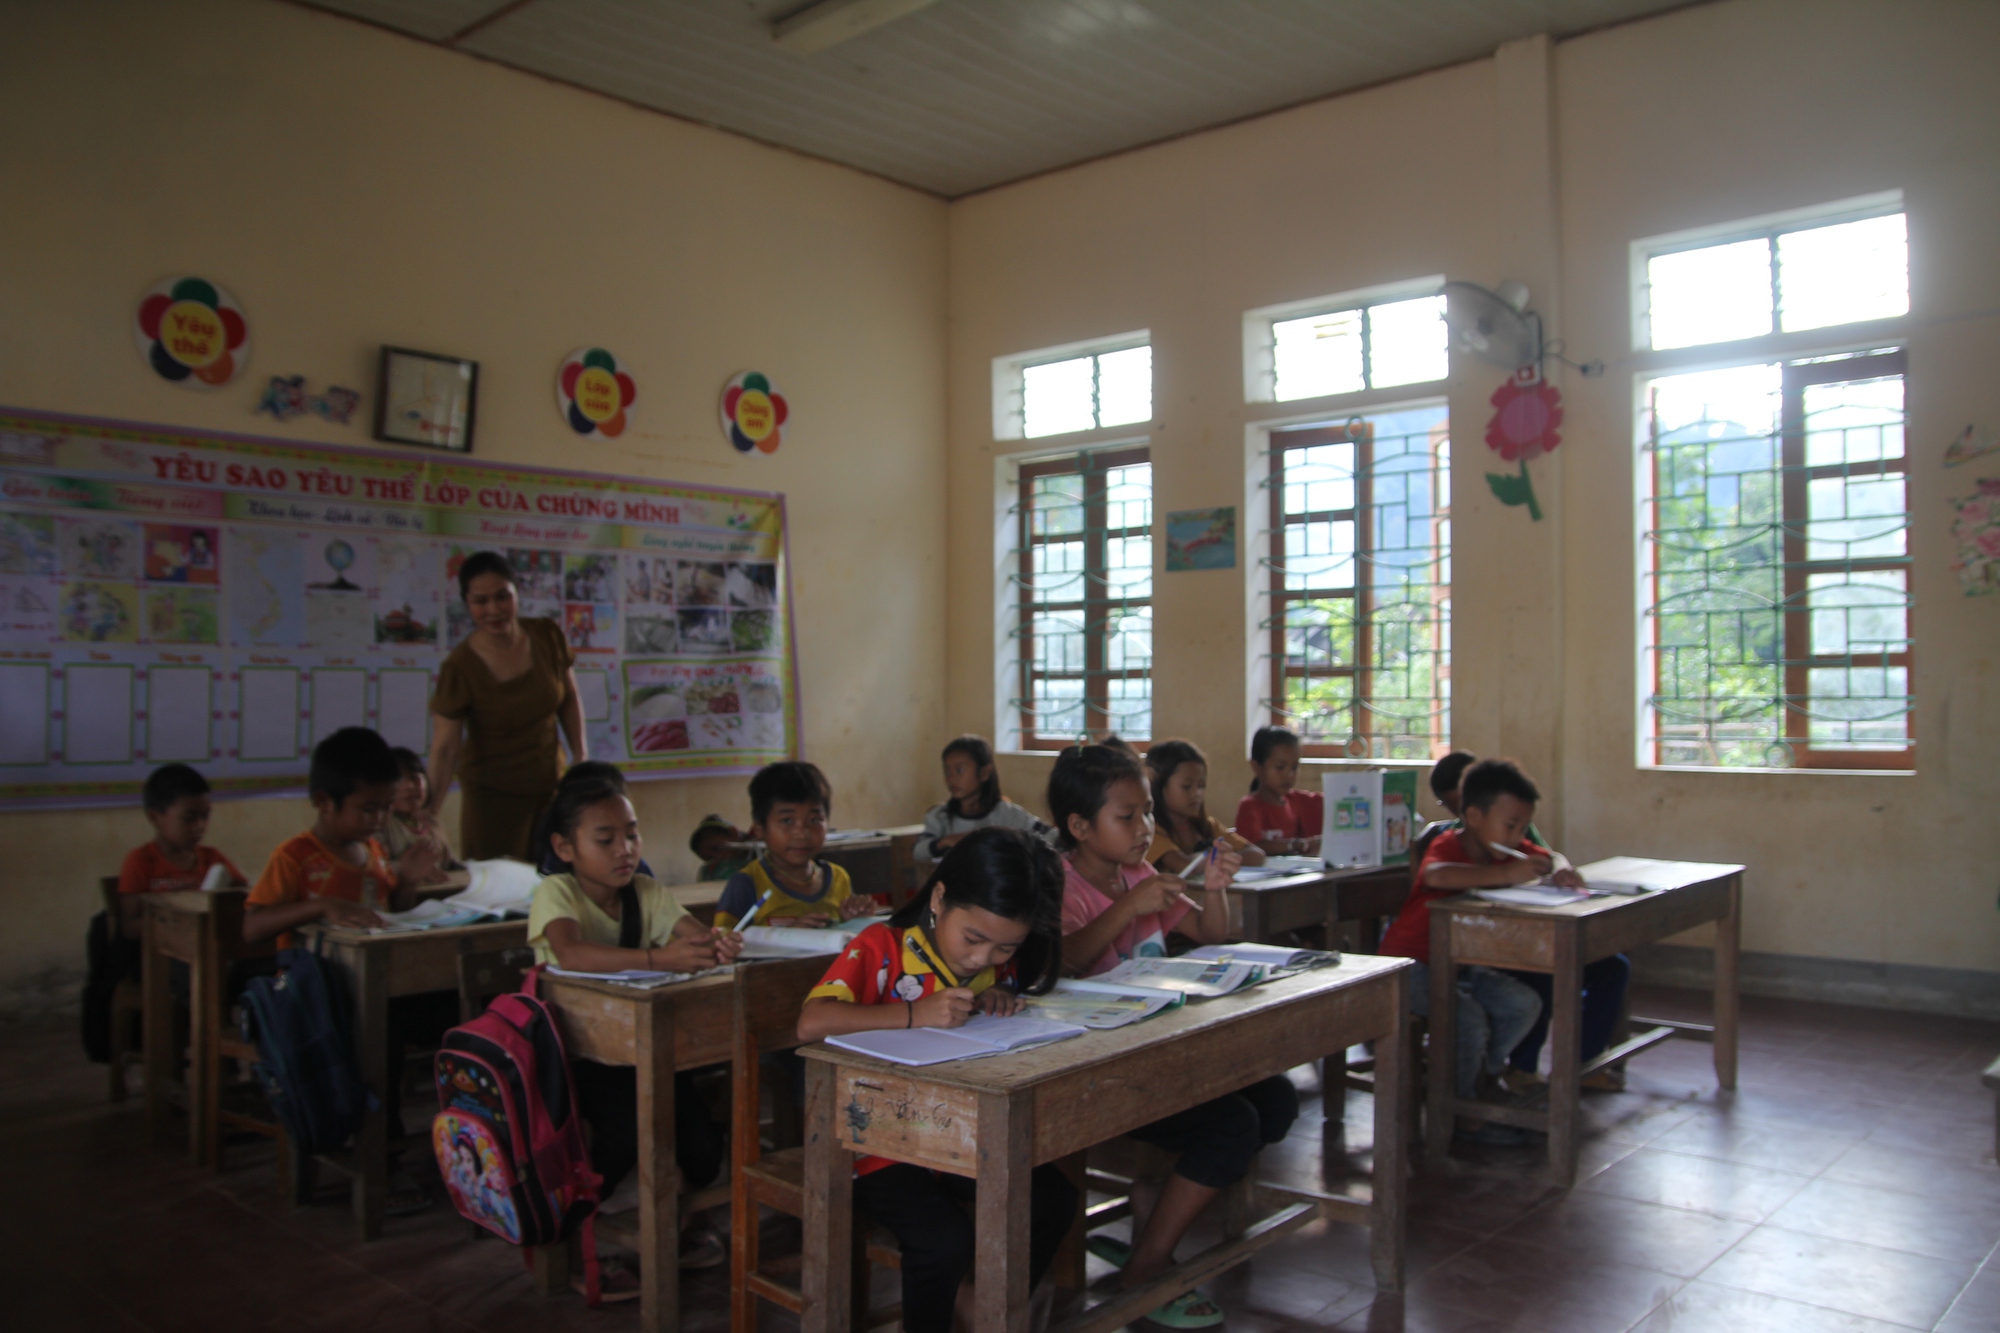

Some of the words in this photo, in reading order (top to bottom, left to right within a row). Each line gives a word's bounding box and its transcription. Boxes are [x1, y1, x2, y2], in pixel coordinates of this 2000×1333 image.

[152, 452, 217, 483] YÊU
[226, 464, 288, 489] SAO
[296, 466, 354, 496] YÊU
[361, 471, 419, 501] THẾ
[423, 478, 472, 505] LỚP
[477, 481, 529, 512] CỦA
[536, 491, 618, 520] CHÚNG
[624, 498, 681, 524] MÌNH
